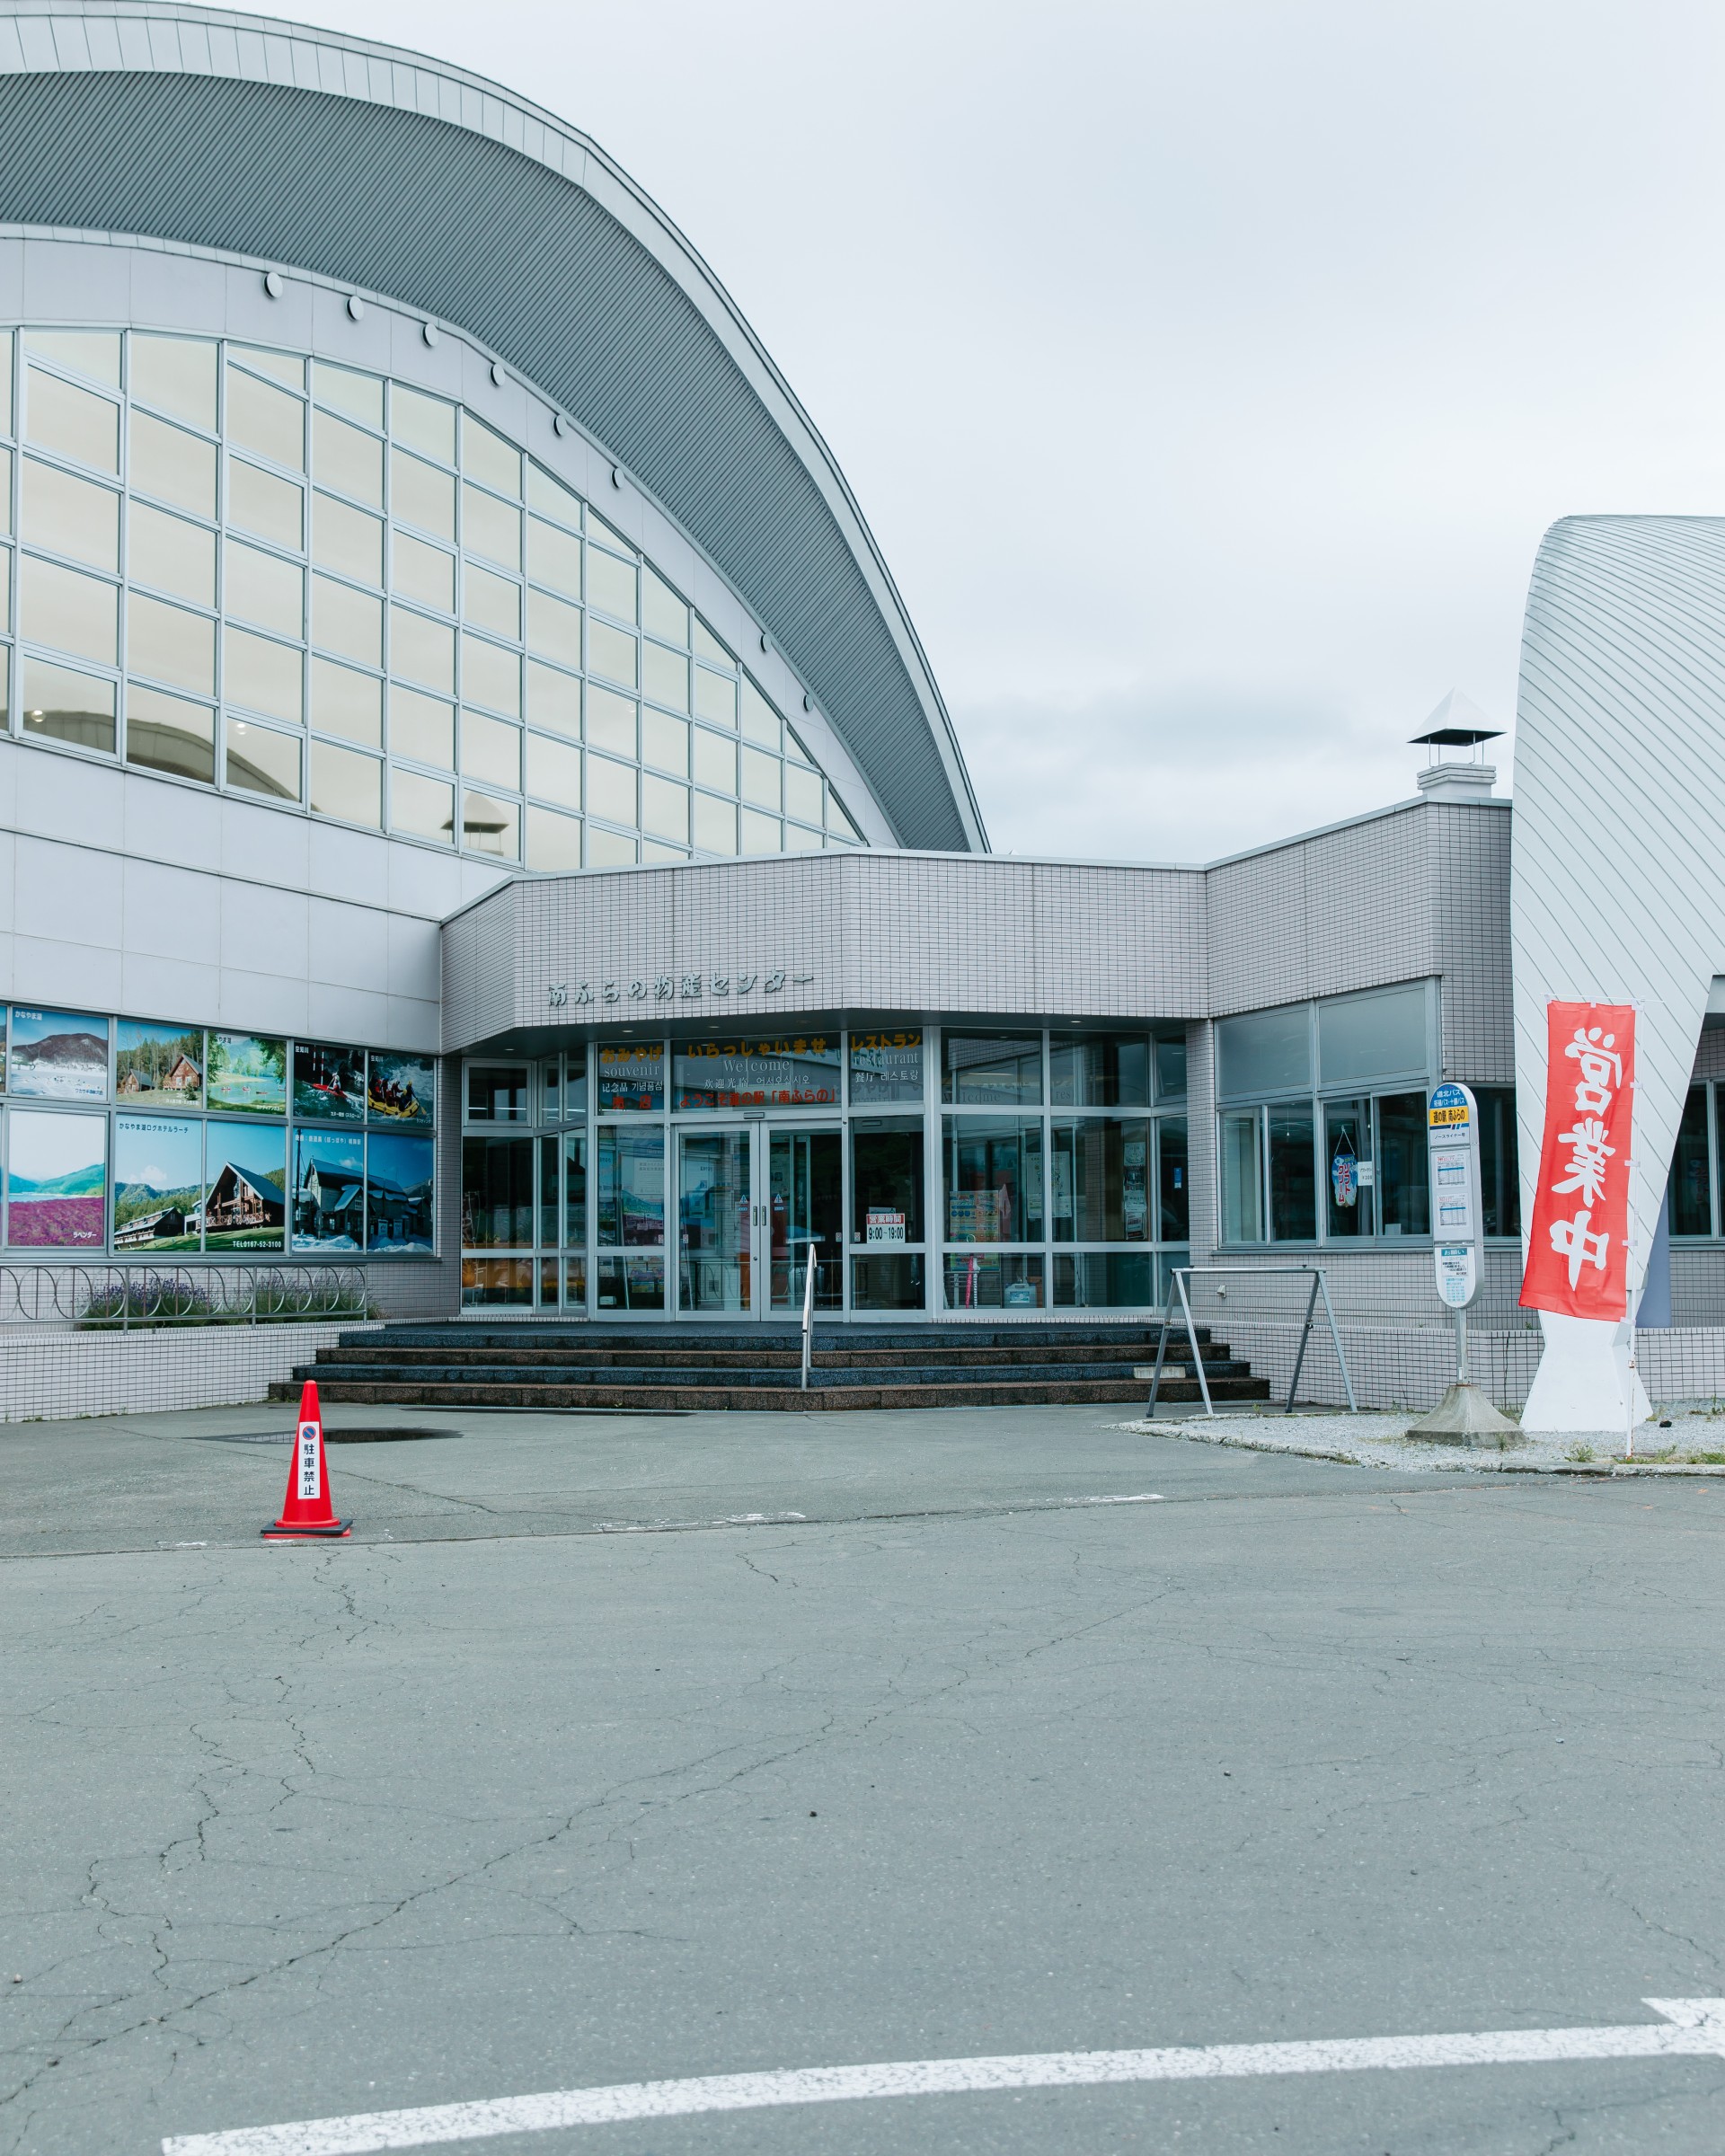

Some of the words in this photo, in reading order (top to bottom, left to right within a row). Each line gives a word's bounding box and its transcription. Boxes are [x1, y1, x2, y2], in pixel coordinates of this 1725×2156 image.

[548, 969, 814, 1007] 南ふらの物産センター
[688, 1038, 827, 1058] いらっしゃいませ
[851, 1034, 921, 1051] レストラン
[601, 1045, 663, 1064] おみやげ
[854, 1051, 919, 1066] restaurant
[604, 1063, 660, 1077] souvenir
[723, 1058, 790, 1073] Welcome
[880, 1069, 919, 1081] 레스토랑
[680, 1089, 836, 1108] ようこそ道の駅「南ふらの」
[119, 1123, 190, 1134] かなやま湖ログホテルラーチ
[1549, 1027, 1623, 1292] 営業中
[73, 1231, 97, 1239] ラベンダー
[304, 1444, 314, 1496] 駐車禁止
